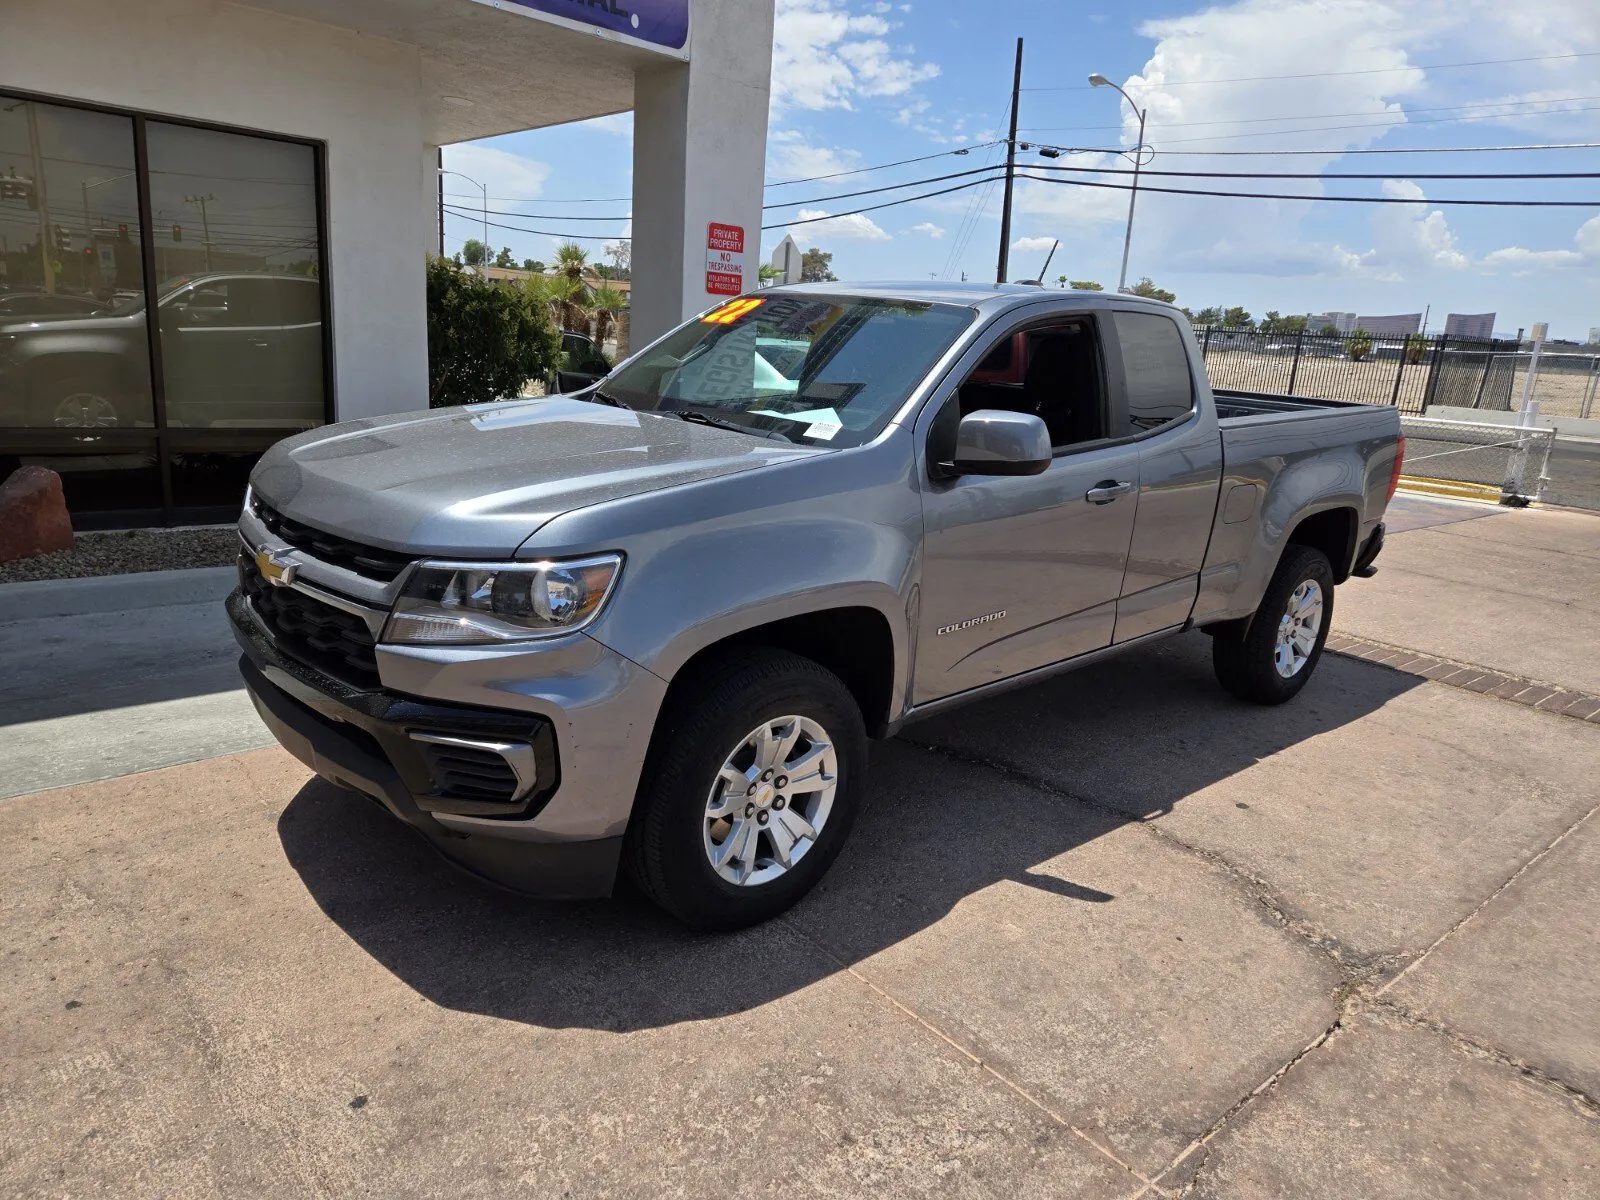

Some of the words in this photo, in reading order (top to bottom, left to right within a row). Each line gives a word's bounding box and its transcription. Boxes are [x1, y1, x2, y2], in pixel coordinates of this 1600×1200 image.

[713, 228, 739, 241] PRIVATE
[710, 238, 742, 250] PROPERTY
[720, 252, 731, 262] NO
[708, 261, 742, 273] TRESPASSING
[708, 274, 730, 283] VIOLATORS
[708, 281, 713, 289] BE
[714, 282, 740, 291] PROSECUTED
[937, 610, 1006, 635] COLORADO
